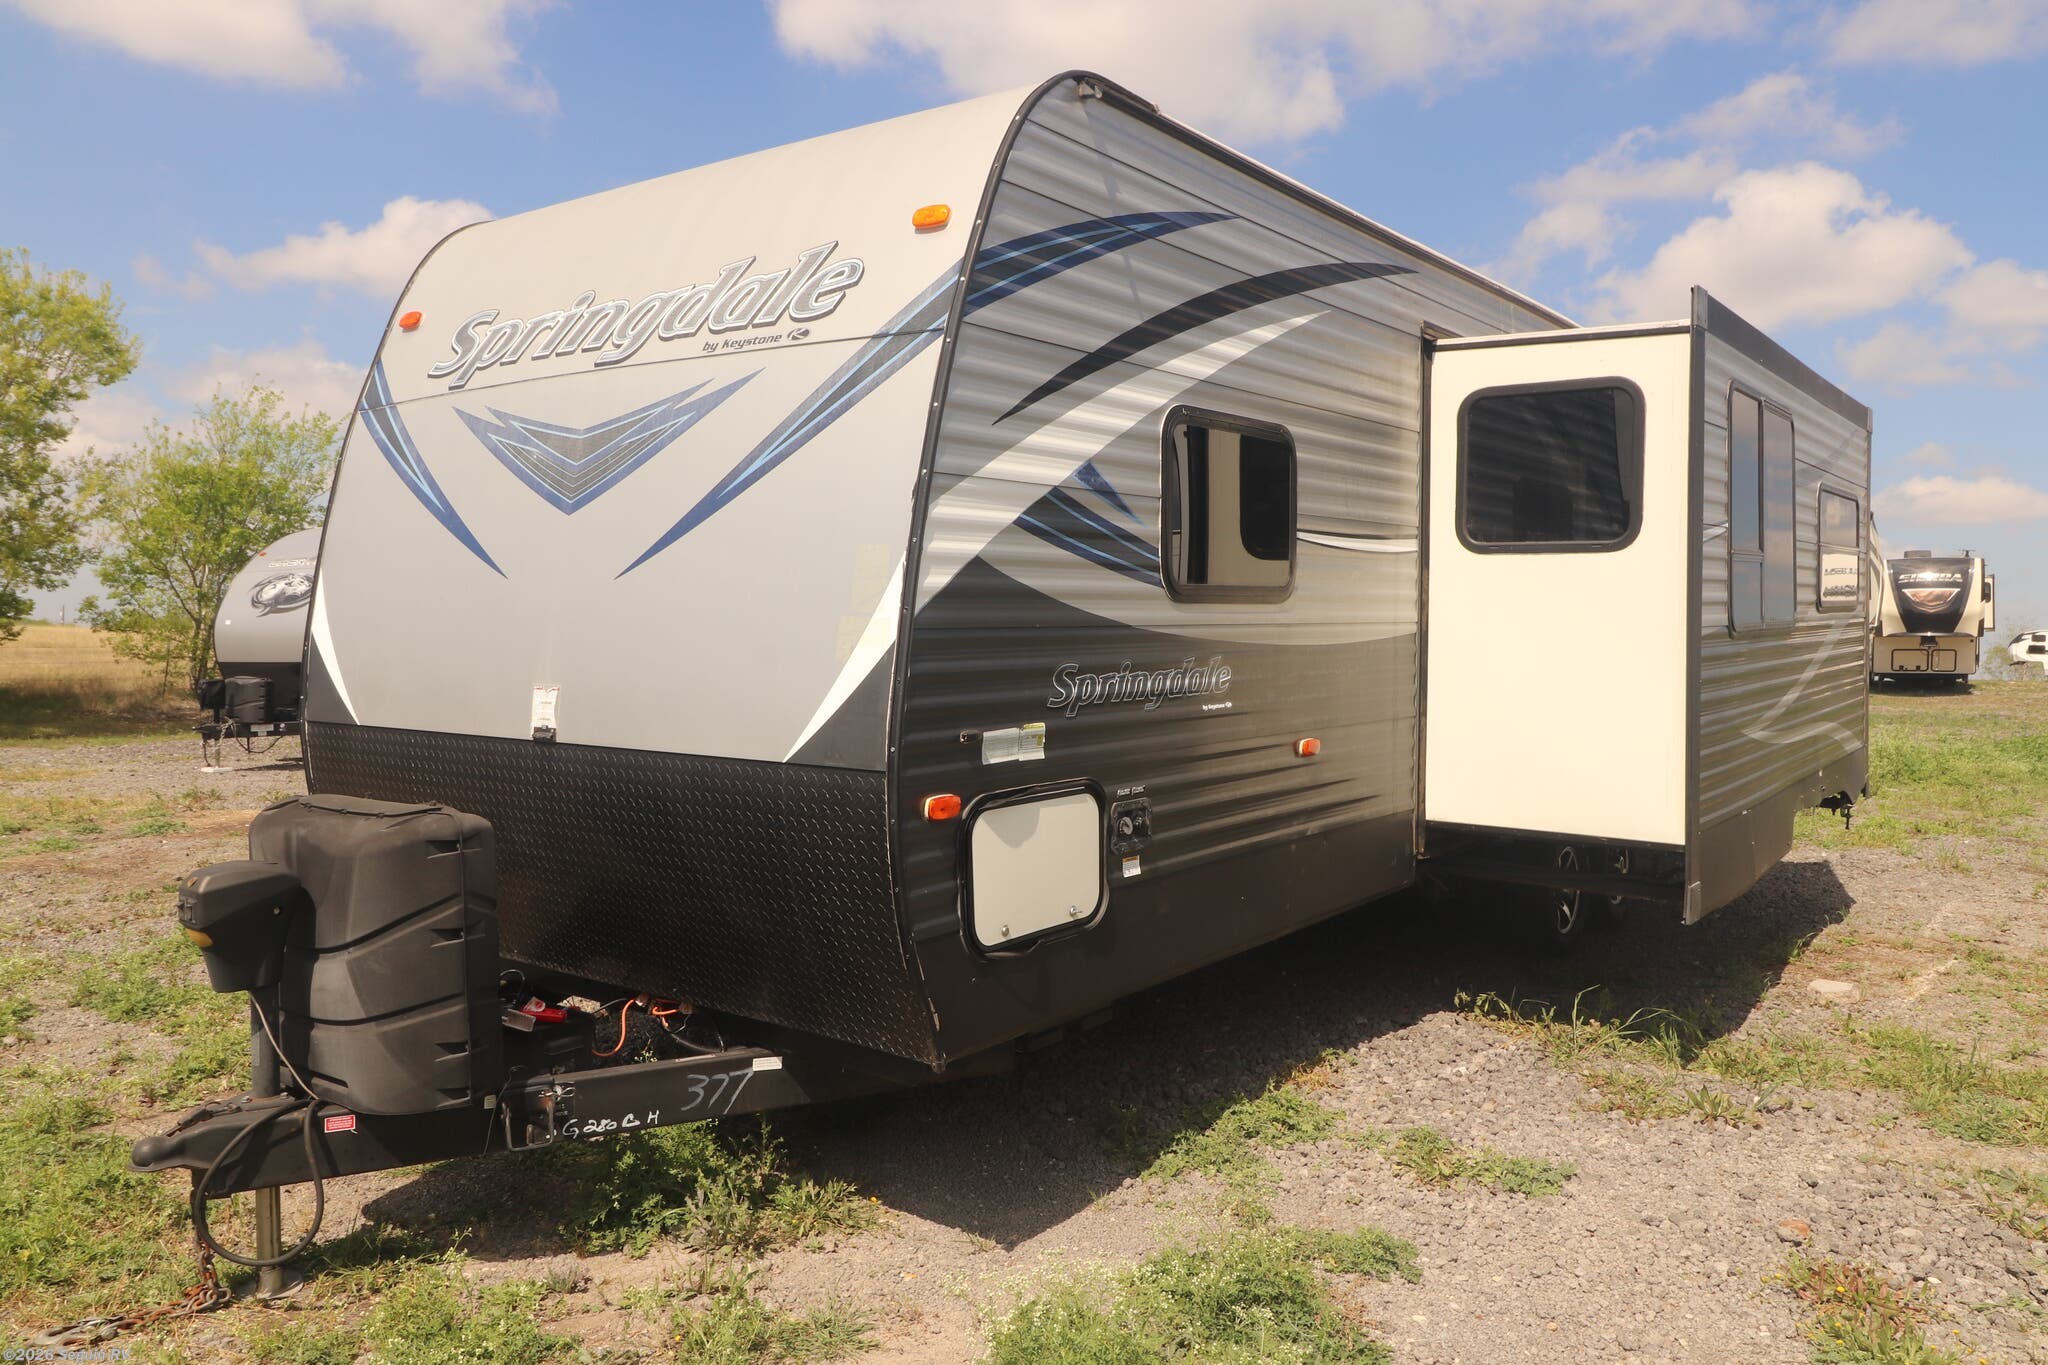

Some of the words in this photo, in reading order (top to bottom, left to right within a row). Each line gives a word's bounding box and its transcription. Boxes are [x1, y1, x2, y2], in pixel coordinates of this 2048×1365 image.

[428, 240, 865, 389] Springdale
[702, 341, 719, 353] by
[722, 334, 782, 349] Keystone
[1046, 656, 1233, 718] Springdale
[680, 1068, 755, 1115] 377
